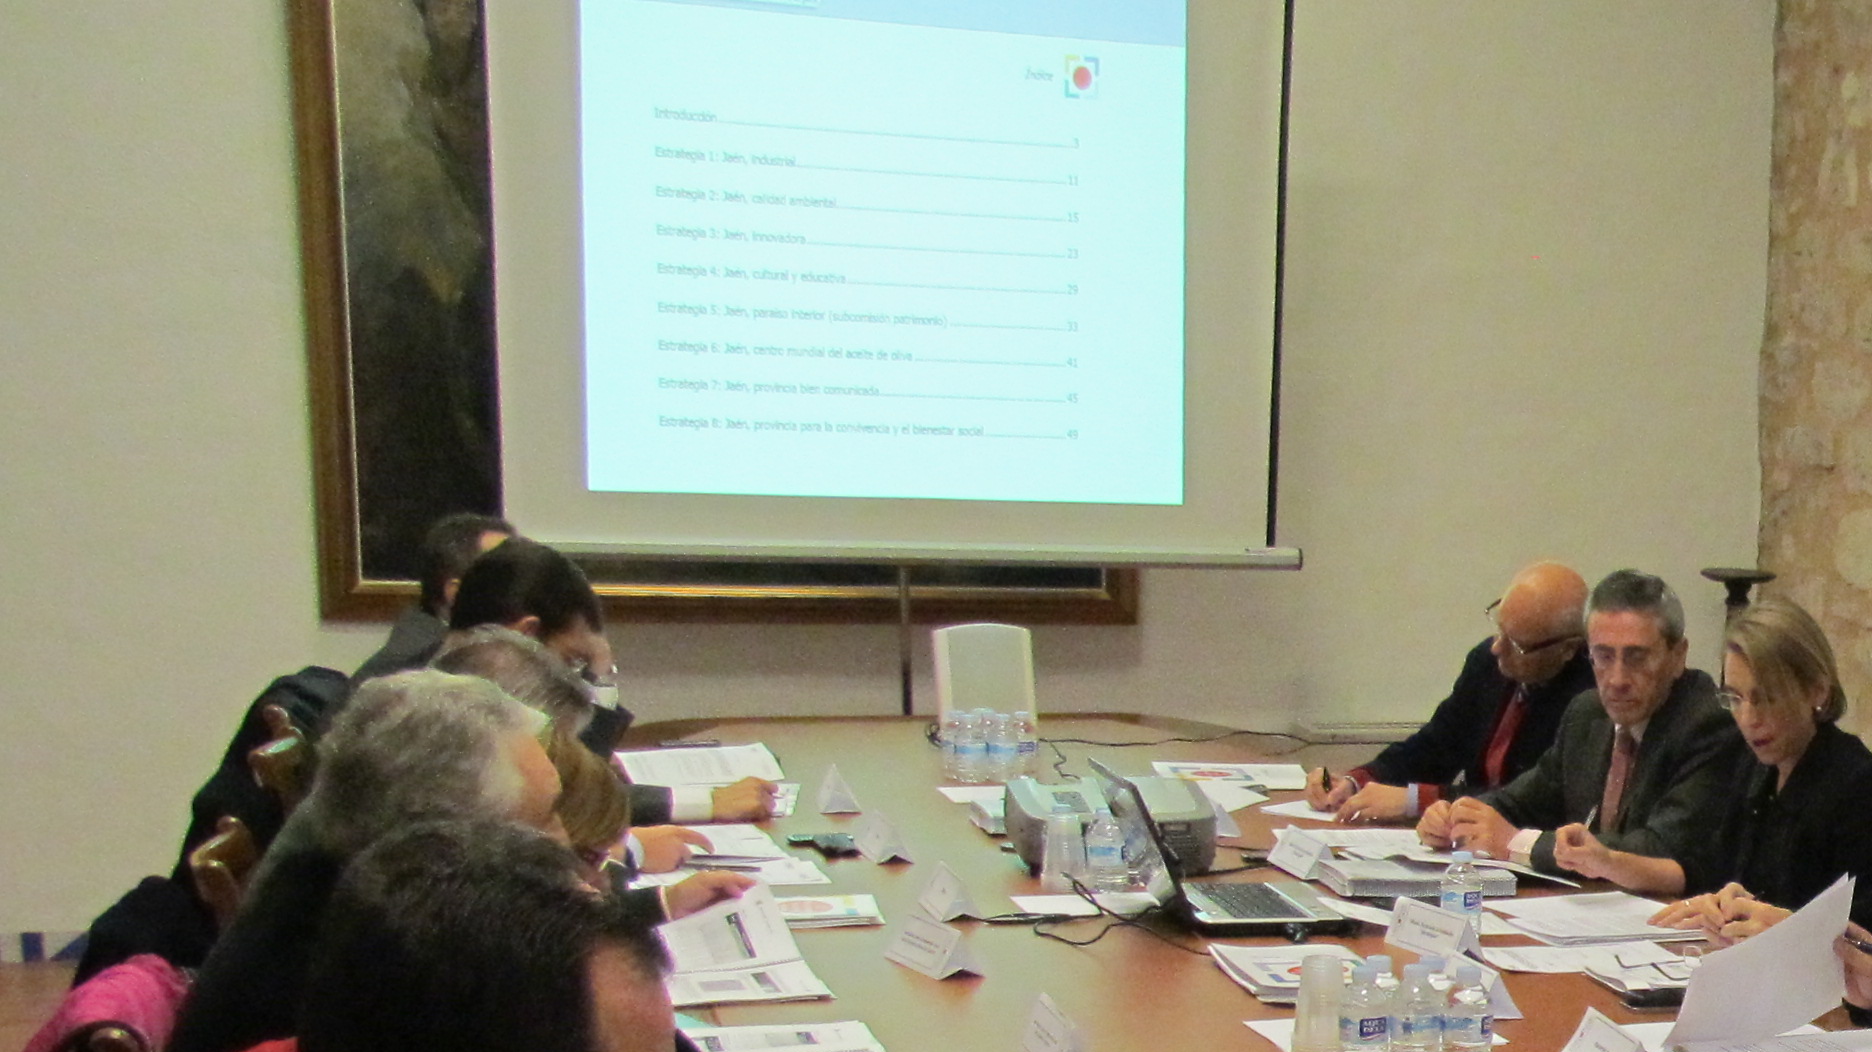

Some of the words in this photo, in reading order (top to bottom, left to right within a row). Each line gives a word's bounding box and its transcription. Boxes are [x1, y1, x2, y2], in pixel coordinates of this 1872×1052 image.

[654, 145, 705, 164] Estrategia
[655, 185, 706, 203] Estrategia
[655, 223, 706, 241] Estrategia
[656, 261, 708, 280] Estrategia
[656, 301, 708, 318] Estrategia
[656, 339, 708, 356] Estrategia
[656, 377, 709, 393] Estrategia
[657, 415, 709, 431] Estrategia
